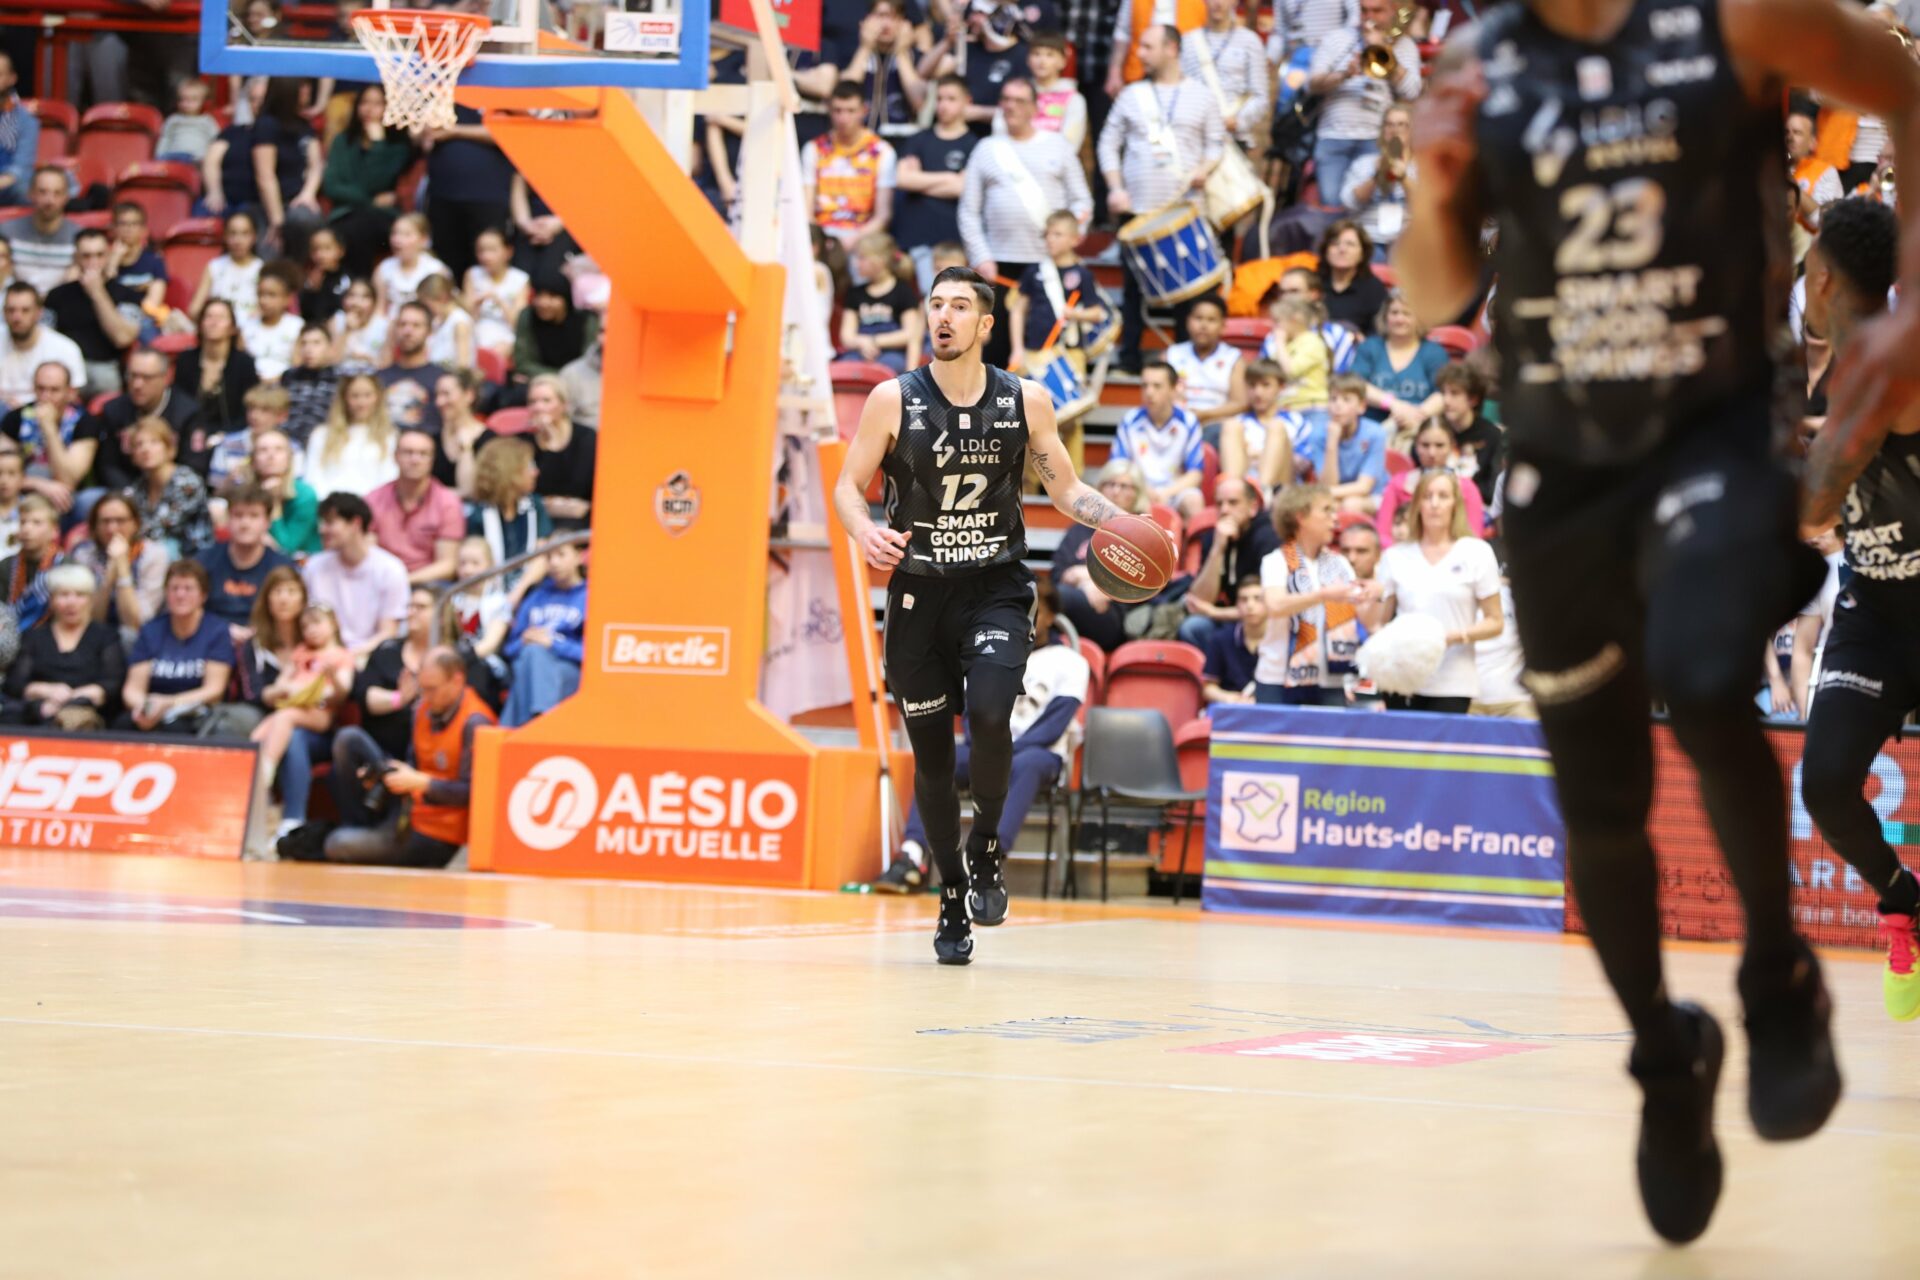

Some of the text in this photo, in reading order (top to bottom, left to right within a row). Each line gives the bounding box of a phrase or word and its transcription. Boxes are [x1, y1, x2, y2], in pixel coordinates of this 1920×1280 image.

[1555, 176, 1666, 275] 23
[997, 396, 1016, 406] DCB
[960, 439, 1001, 452] LDLC
[960, 454, 1000, 464] ASVEL
[940, 473, 988, 511] 12
[936, 511, 998, 530] SMART
[930, 530, 985, 546] GOOD
[932, 543, 1000, 563] THINGS
[599, 772, 798, 830] AÉSIO
[1304, 789, 1387, 815] Région
[595, 825, 782, 862] MUTUELLE
[1302, 817, 1555, 857] Hauts-de-France
